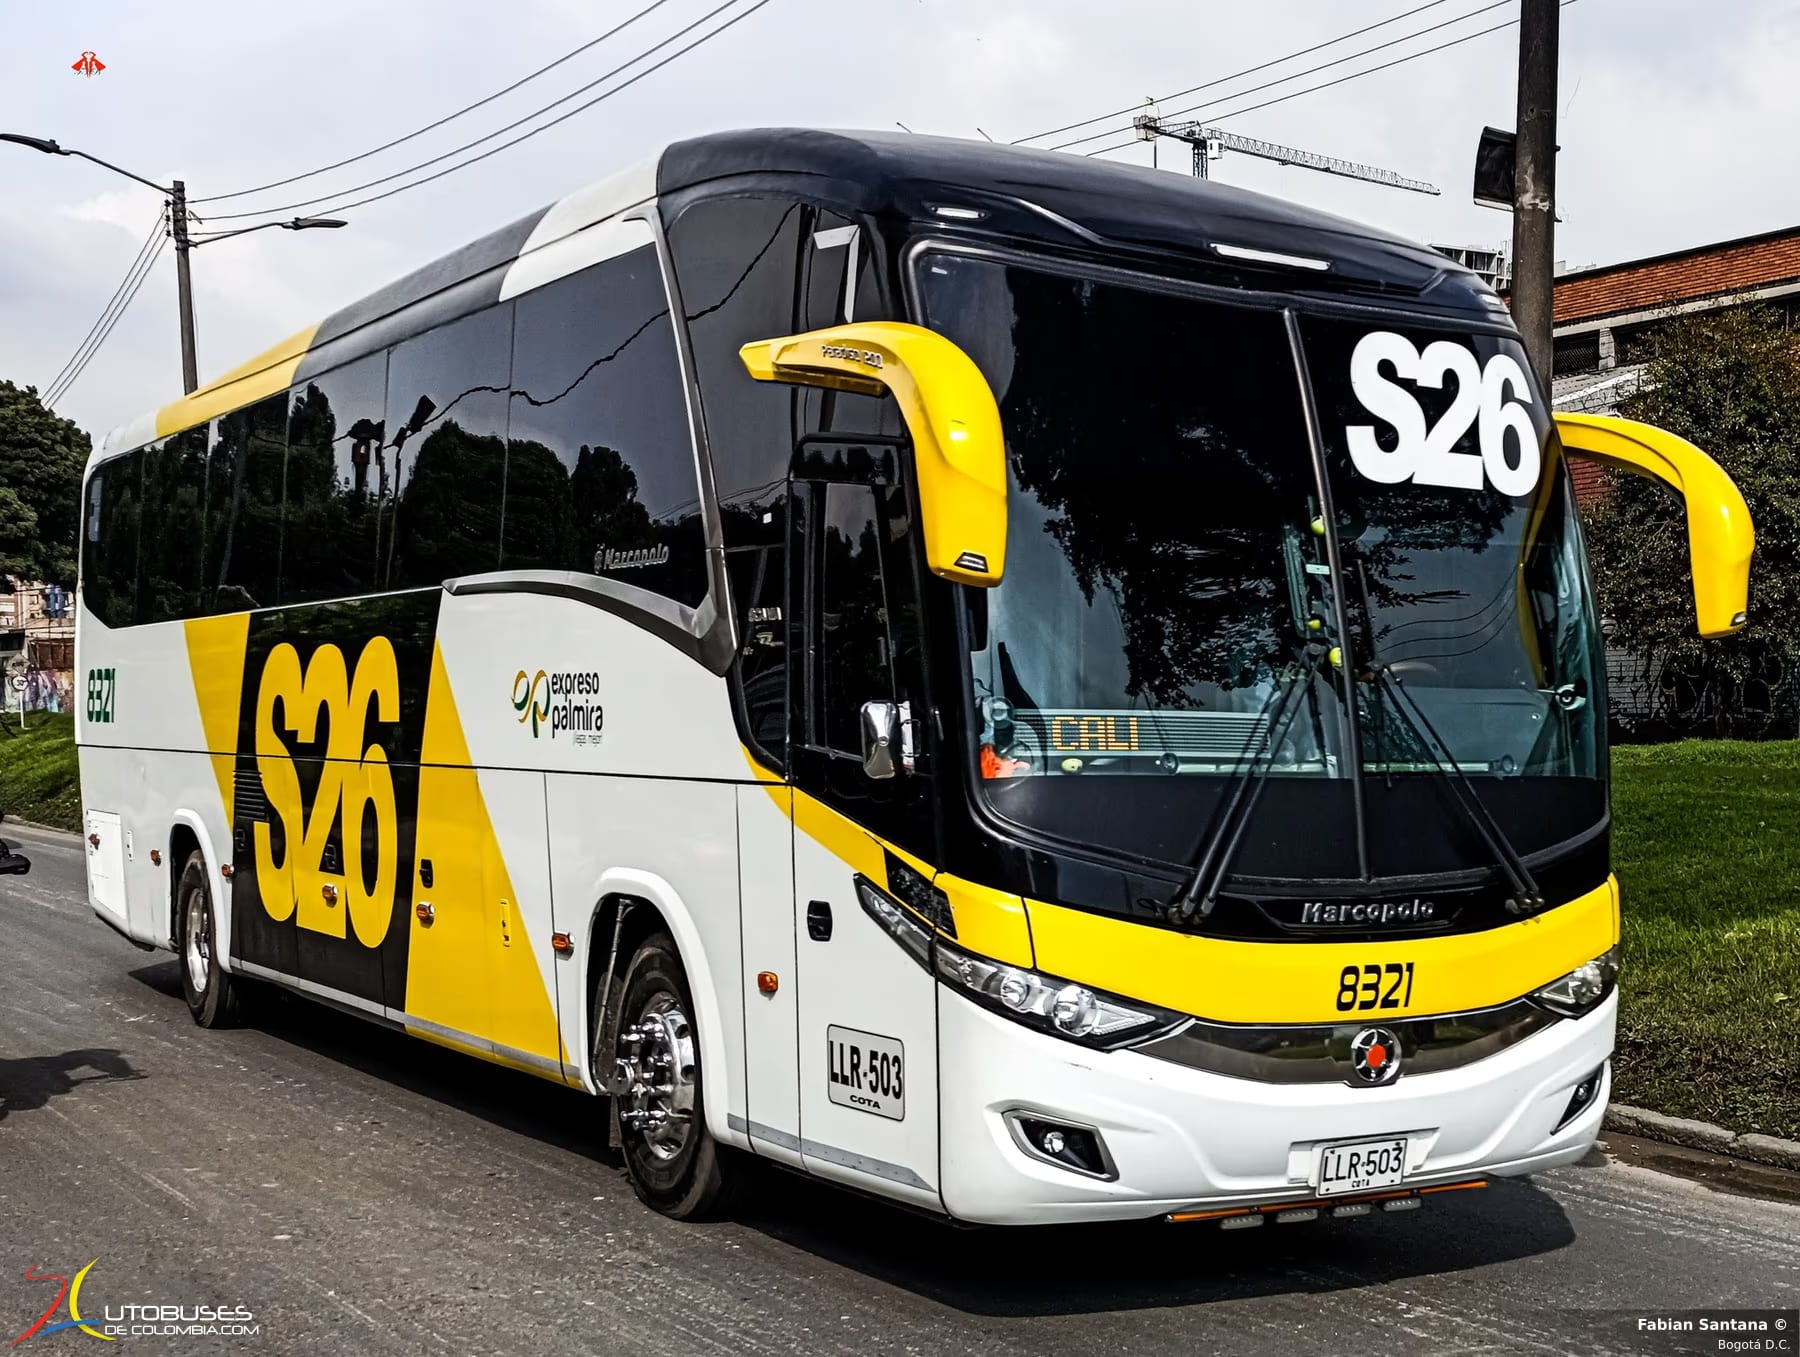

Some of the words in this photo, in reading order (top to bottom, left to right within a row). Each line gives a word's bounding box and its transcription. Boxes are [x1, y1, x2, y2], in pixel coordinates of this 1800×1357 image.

[1345, 331, 1541, 497] S26
[602, 542, 669, 571] Marcopolo
[87, 668, 116, 723] 8321
[551, 672, 600, 702] expreso
[551, 699, 603, 739] palmira
[1052, 716, 1139, 750] CALI
[253, 635, 400, 948] S26
[1301, 899, 1434, 923] Marcopolo
[1336, 962, 1414, 1012] 8321
[829, 1040, 902, 1100] LLR-503
[849, 1094, 881, 1109] COTA
